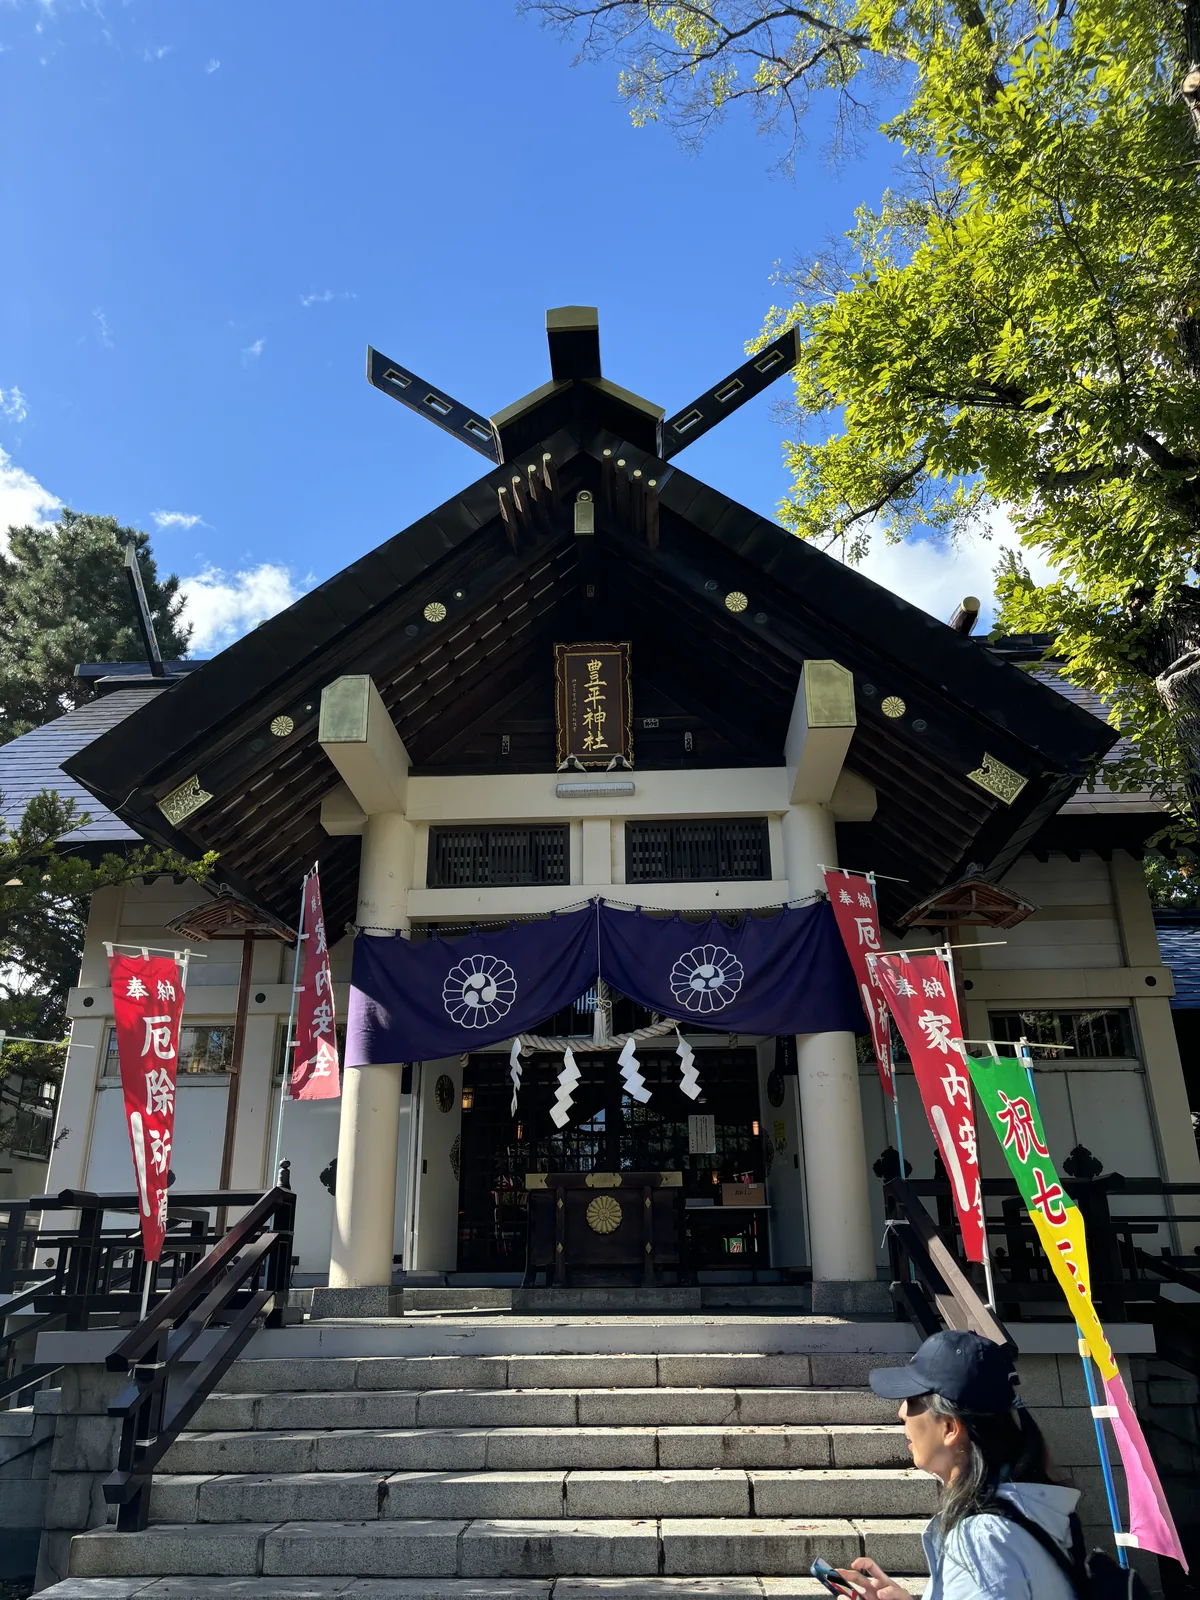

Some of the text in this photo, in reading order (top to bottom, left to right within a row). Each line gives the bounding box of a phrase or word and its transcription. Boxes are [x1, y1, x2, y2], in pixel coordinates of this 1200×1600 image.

[581, 658, 609, 752] 豊平神社
[838, 888, 873, 909] 奉納
[126, 975, 176, 1002] 奉納
[895, 974, 946, 999] 奉納
